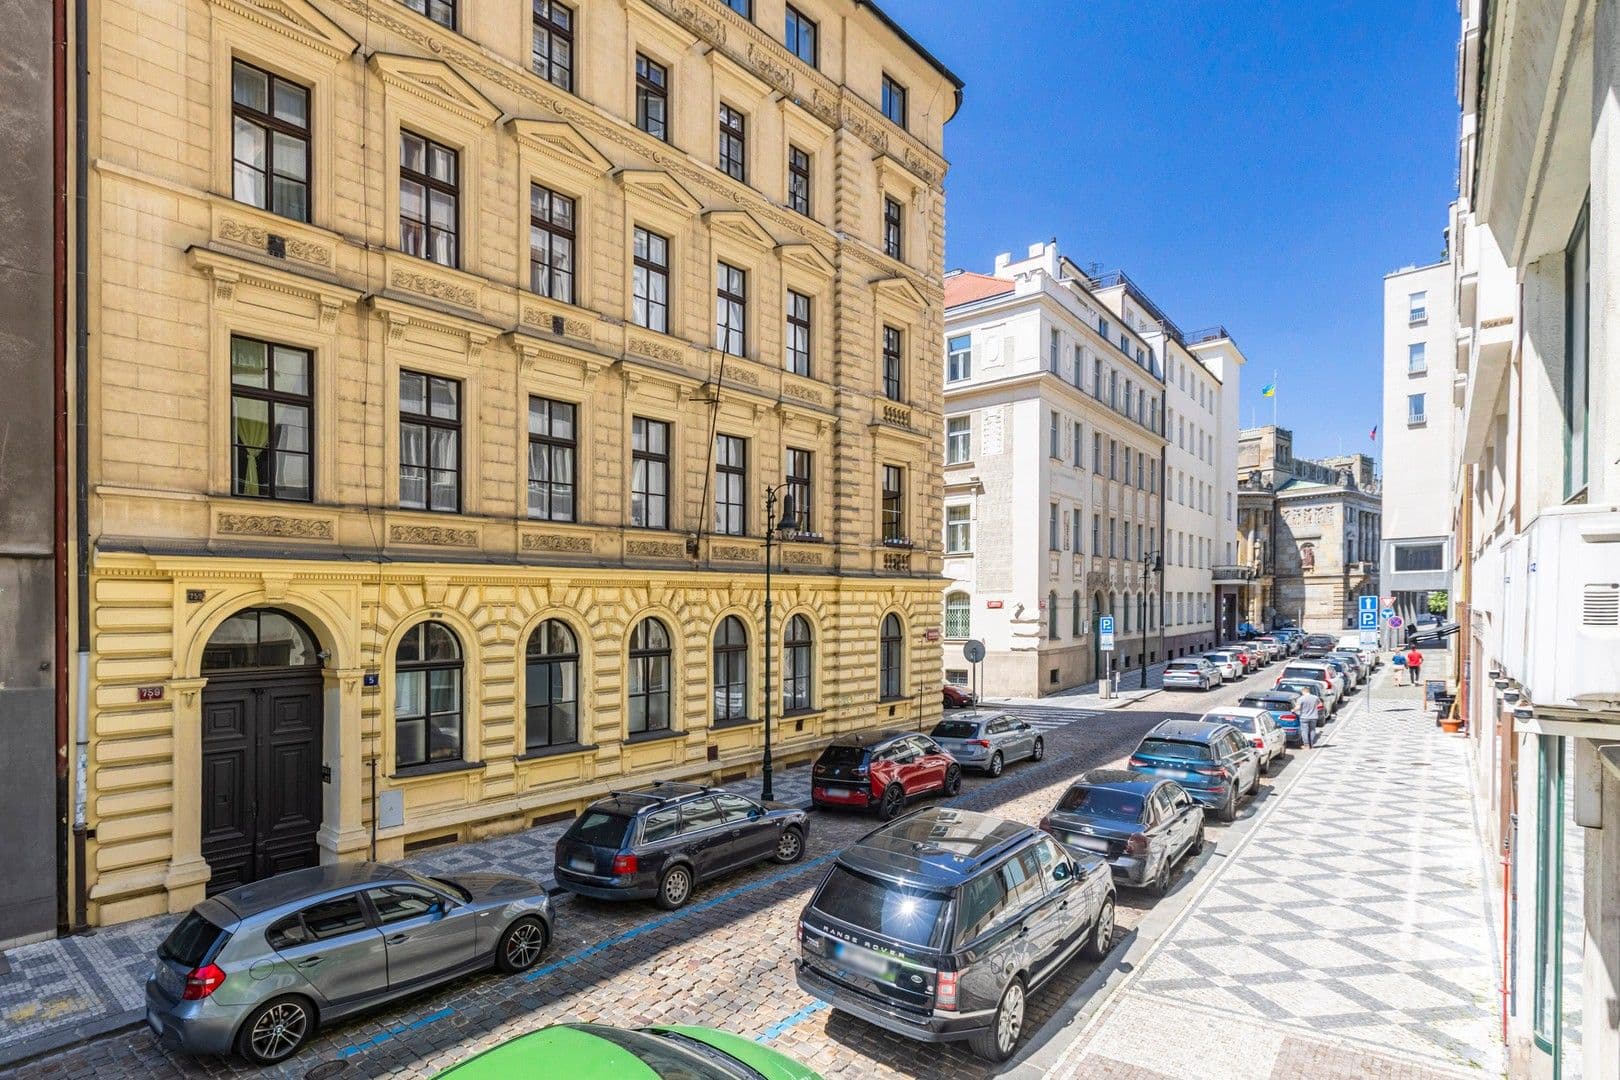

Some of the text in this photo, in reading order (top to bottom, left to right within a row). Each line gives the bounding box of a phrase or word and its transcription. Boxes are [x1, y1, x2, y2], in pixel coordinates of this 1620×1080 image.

[1362, 613, 1372, 624] P
[1103, 619, 1111, 629] P
[141, 688, 161, 697] 759
[823, 925, 858, 943] RANGE
[864, 941, 905, 959] ROVER
